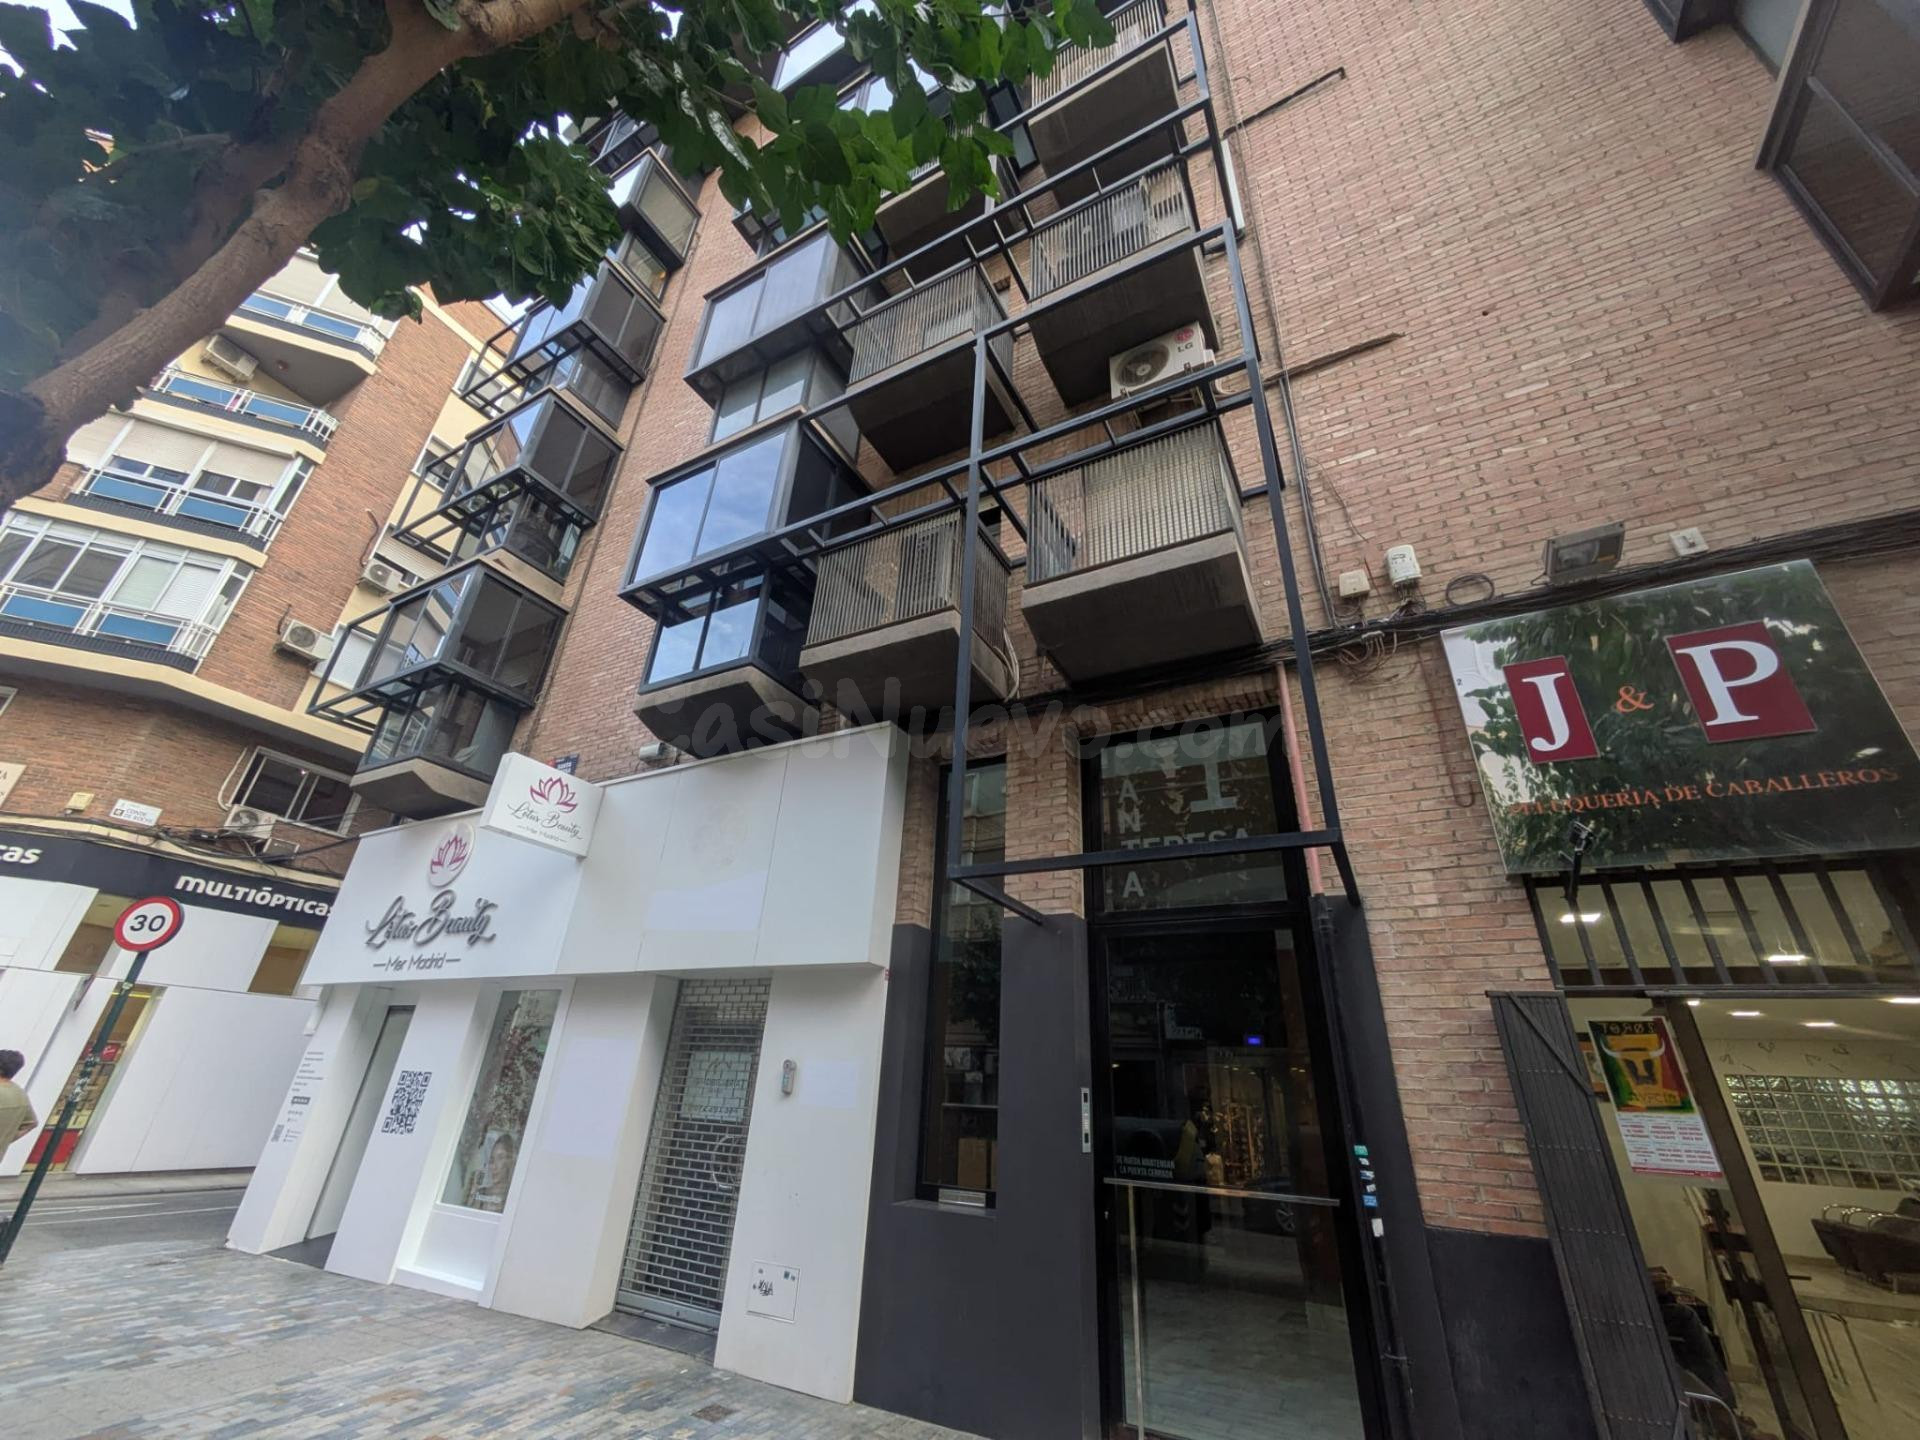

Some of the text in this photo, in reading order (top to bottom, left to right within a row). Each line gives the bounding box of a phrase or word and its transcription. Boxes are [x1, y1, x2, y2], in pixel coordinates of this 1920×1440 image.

[1177, 342, 1194, 353] LG
[1522, 640, 1778, 752] J & P
[1663, 785, 1700, 801] DE
[1706, 767, 1899, 798] CABALLEROS
[541, 811, 584, 840] Beauty
[130, 914, 166, 932] 30
[413, 889, 498, 947] Beauty
[407, 951, 448, 971] Madrid
